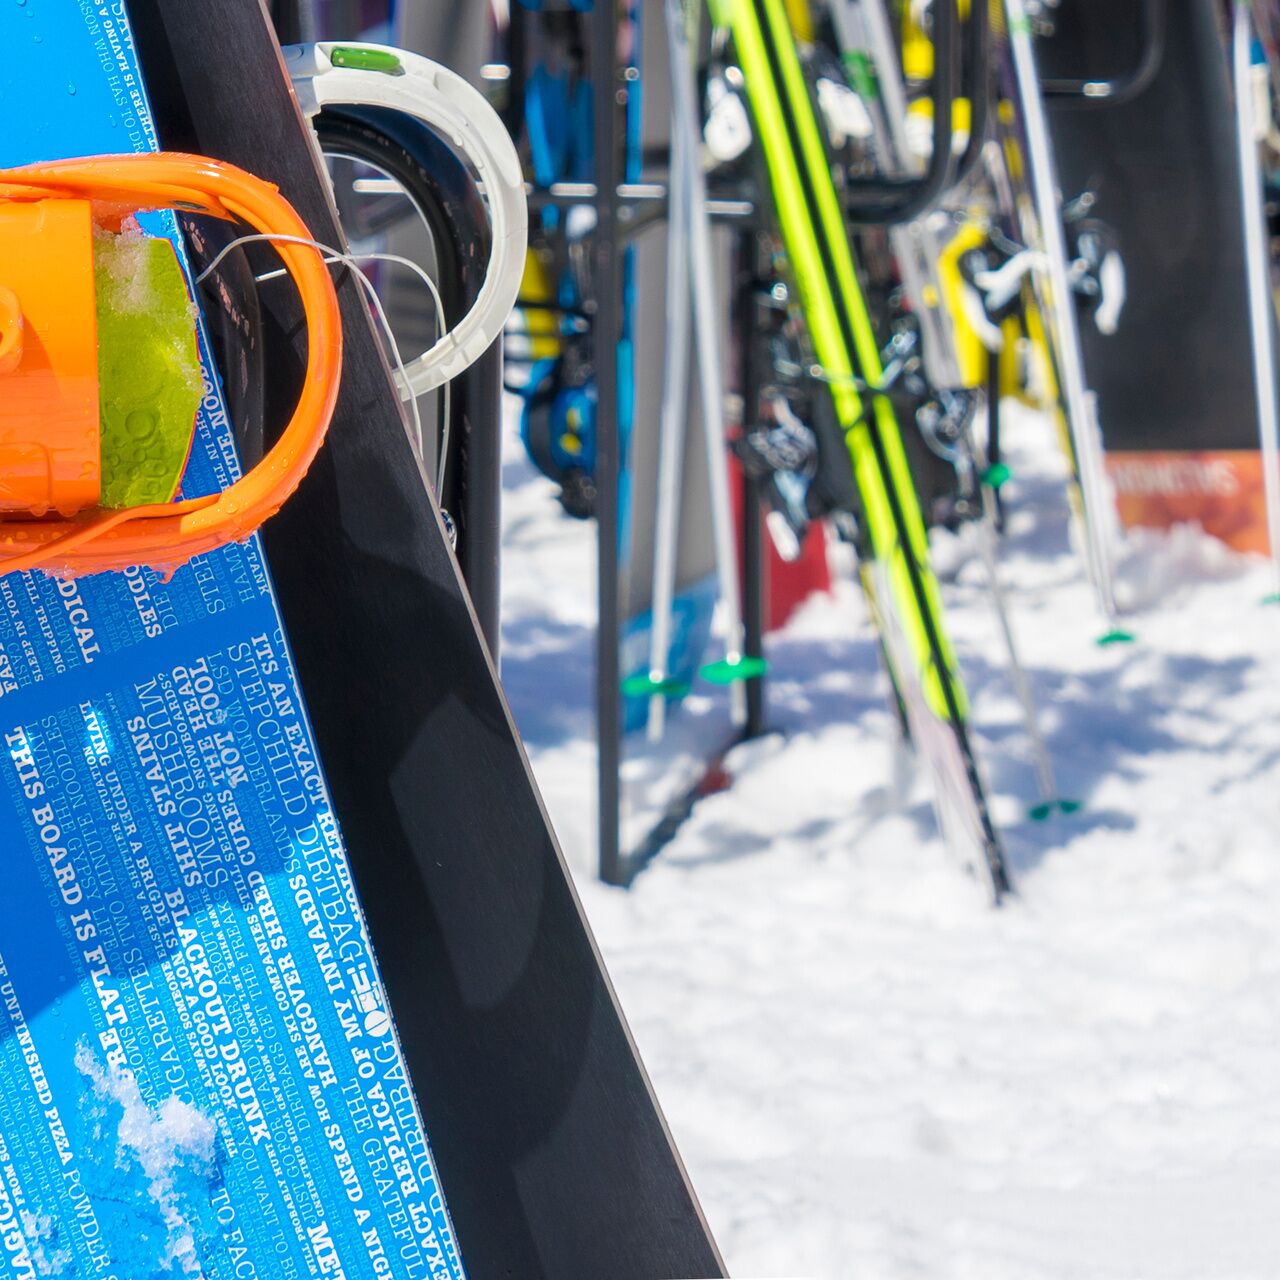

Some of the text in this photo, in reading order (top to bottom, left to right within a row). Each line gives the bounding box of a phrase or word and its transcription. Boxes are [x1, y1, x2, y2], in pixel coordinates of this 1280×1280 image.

[125, 715, 202, 888] SHIT STAINS
[133, 676, 229, 889] MUSHROOMS
[186, 657, 248, 788] NOT COOL
[225, 640, 364, 965] STEPCHILD DIRTBAG
[250, 632, 326, 807] ITS AN EXACT
[2, 726, 128, 1027] THIS BOARD IS FLAT
[78, 700, 238, 1112] LIVING UNDER A BRIGDE IS NOT A GOOD LOOK
[157, 671, 330, 1122] HOW ARE SKI COMPANIES STILL SELLING SNOWBOARDS?
[170, 664, 337, 1088] HANGOVER SHRED CURES THE HEAD
[163, 888, 271, 1146] BLACKOUT DRUNK
[287, 874, 450, 1280] EXACT REPLICA OF MY INNARDS
[371, 1039, 437, 1185] DIRTBAG
[43, 1107, 74, 1165] PIZZA
[60, 1167, 112, 1272] POWDER
[322, 1122, 372, 1227] SPEND A
[338, 1077, 426, 1279] THE GRATEFUL
